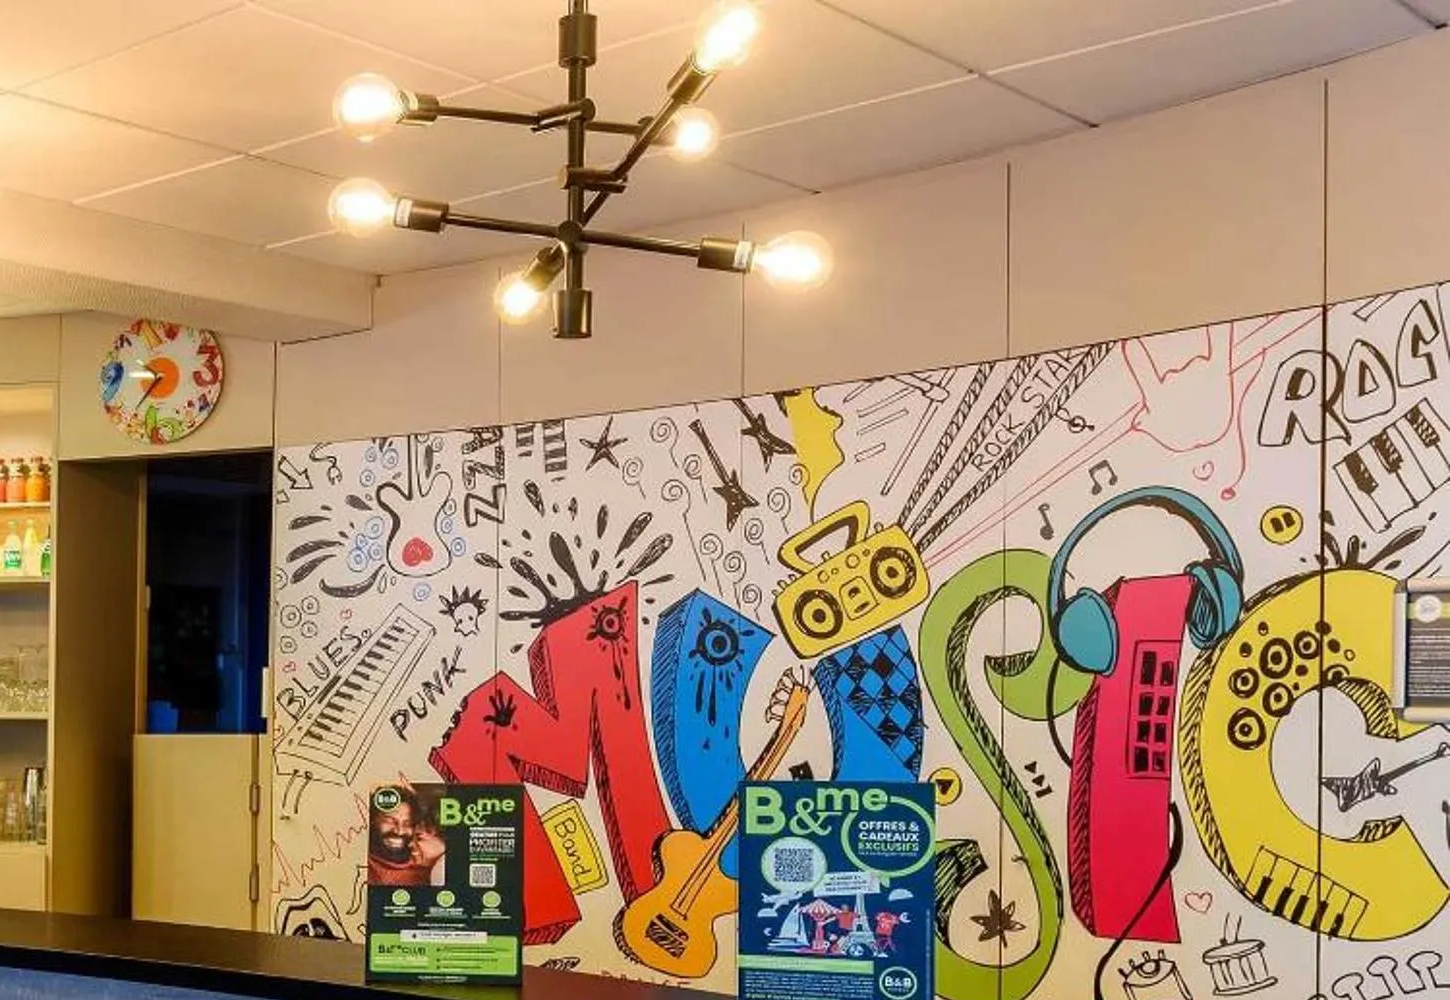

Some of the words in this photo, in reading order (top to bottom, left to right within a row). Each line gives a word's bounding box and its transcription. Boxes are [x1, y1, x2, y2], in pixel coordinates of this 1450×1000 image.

[1259, 286, 1450, 447] ROC
[970, 413, 1026, 472] ROCK
[277, 626, 362, 721] BLUES
[390, 645, 466, 743] PUNK
[554, 817, 590, 885] Band
[858, 820, 906, 831] OFFRES
[909, 821, 920, 832] &
[858, 832, 920, 842] CADEAUX
[858, 842, 920, 852] EXCLUSIFS
